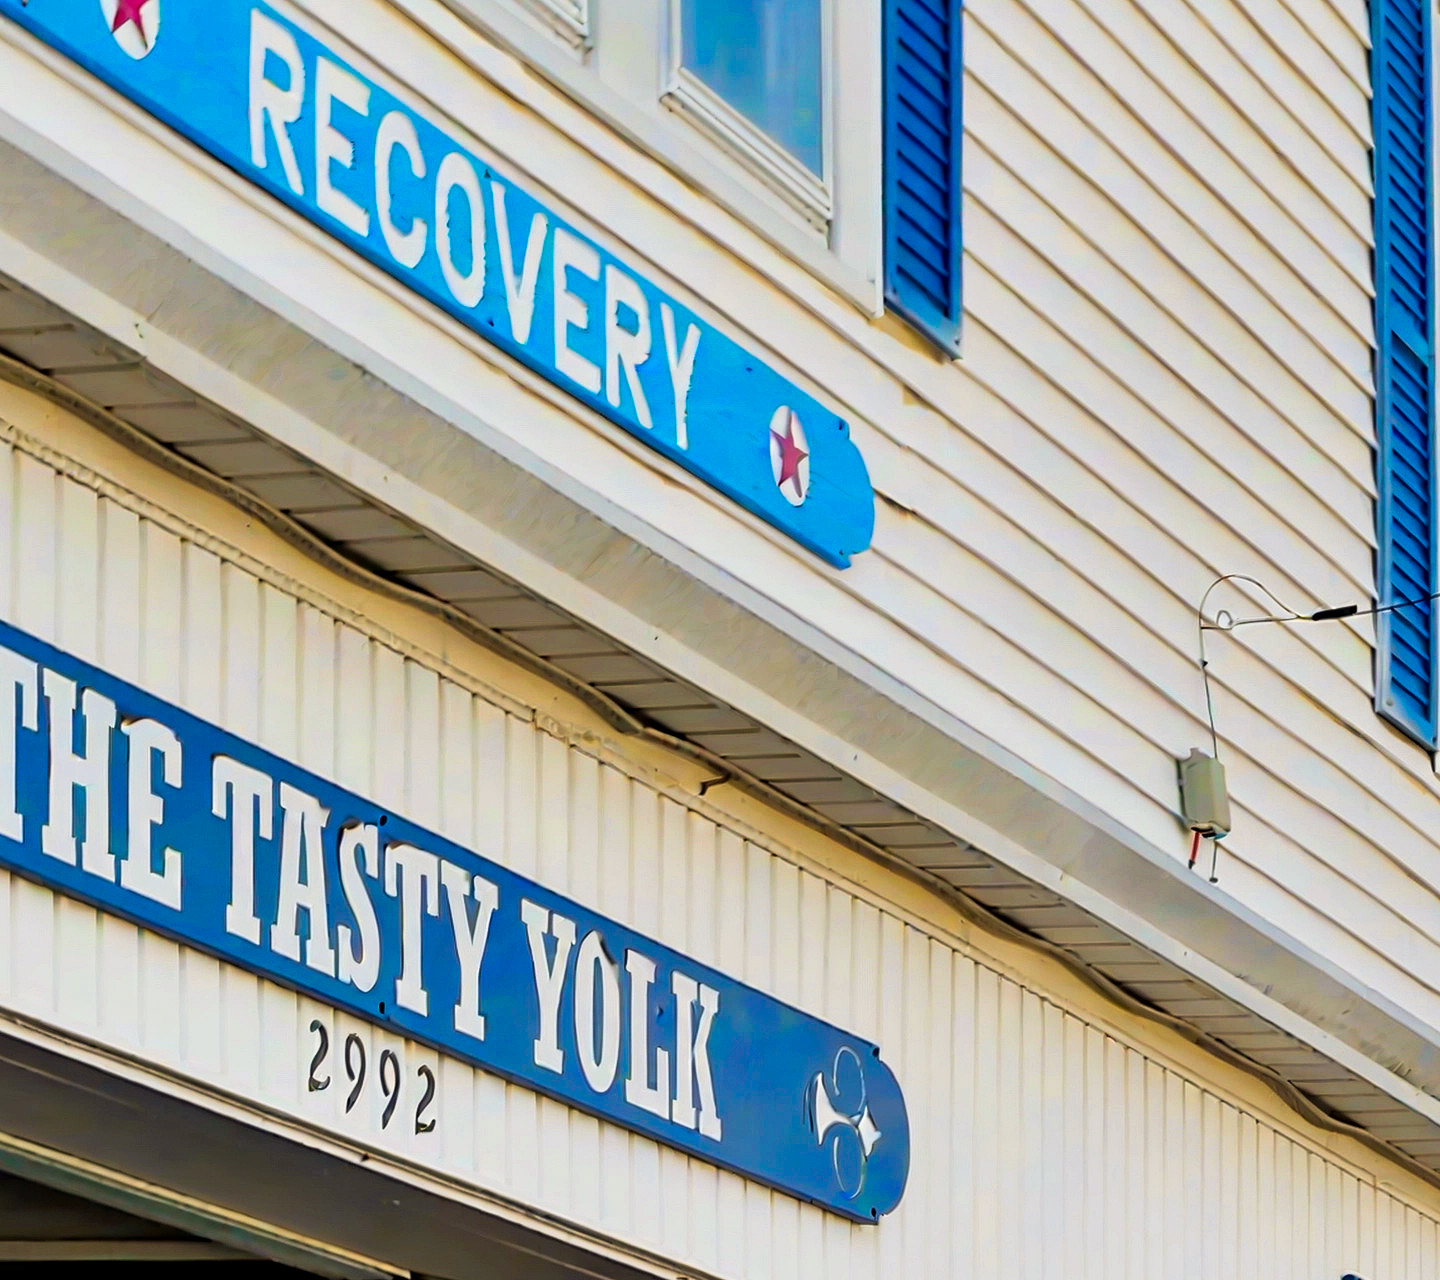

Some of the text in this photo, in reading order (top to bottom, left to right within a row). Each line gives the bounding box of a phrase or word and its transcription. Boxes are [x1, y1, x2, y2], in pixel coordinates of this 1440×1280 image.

[248, 10, 702, 450] RECOVERY
[211, 752, 500, 1041] TASTY
[521, 896, 723, 1143] YOLK
[308, 1018, 437, 1135] 2992
